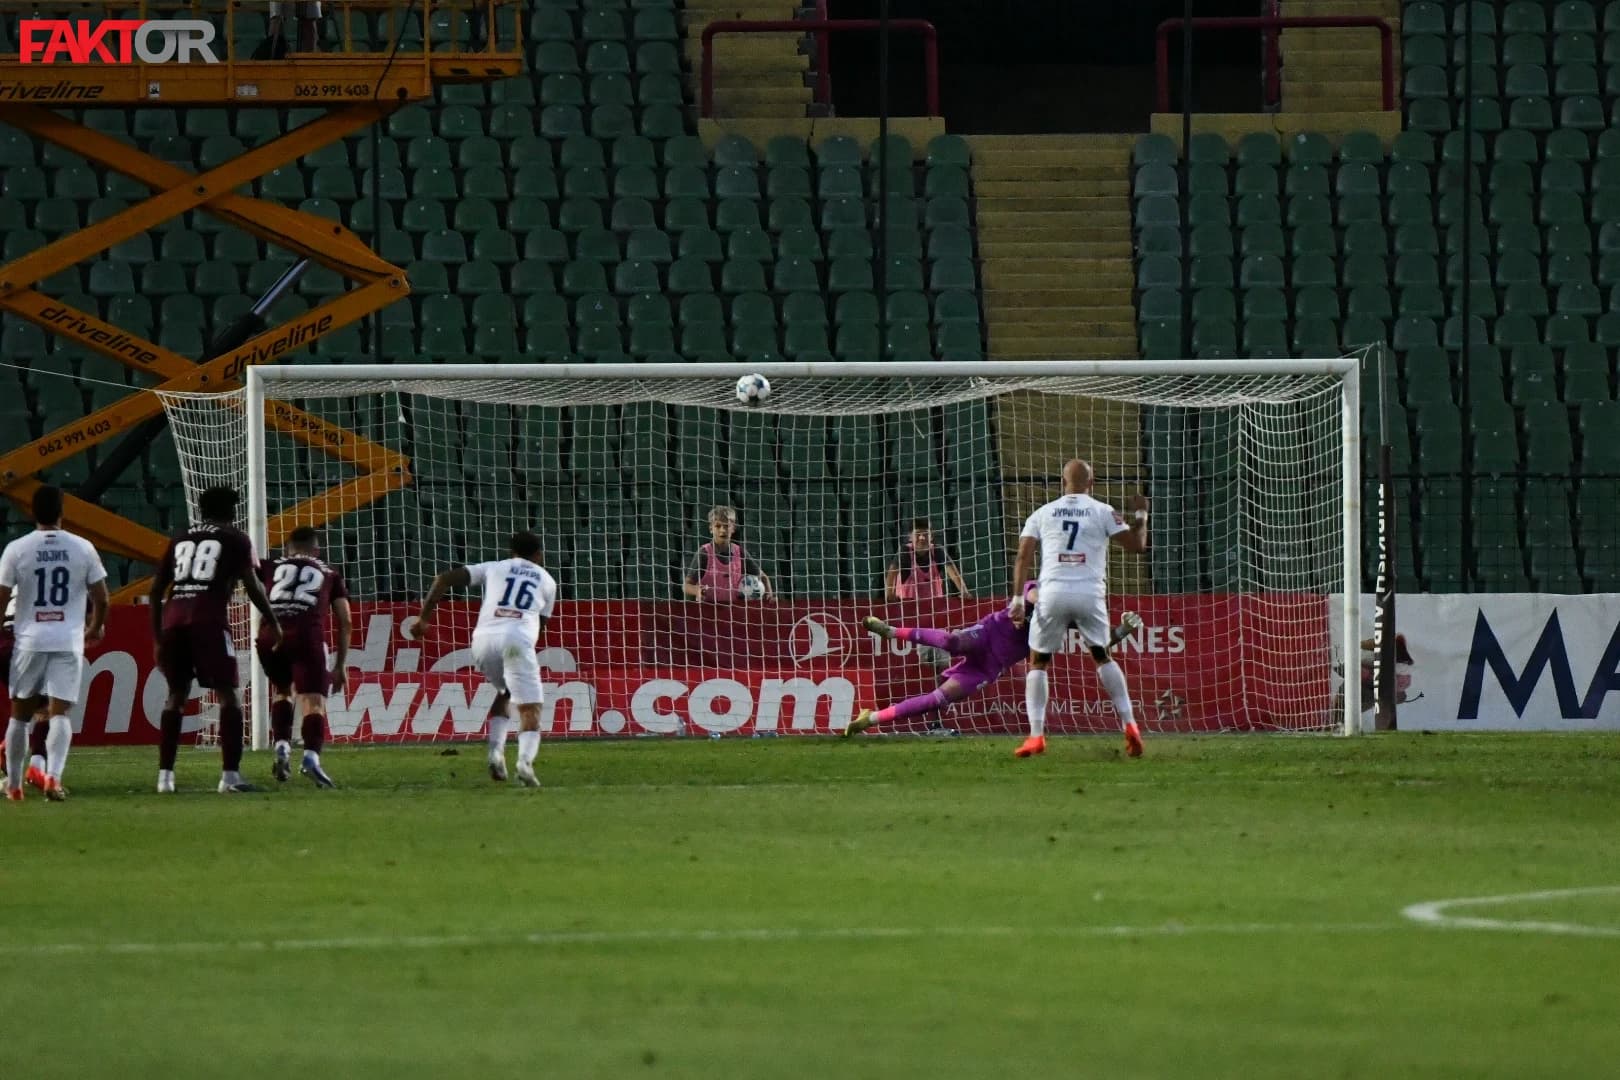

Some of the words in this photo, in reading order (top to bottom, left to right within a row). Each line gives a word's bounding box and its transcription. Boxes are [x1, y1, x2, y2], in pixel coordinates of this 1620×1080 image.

[0, 82, 104, 100] riveline
[294, 84, 319, 97] 062
[321, 84, 343, 97] 991
[345, 84, 369, 97] 403
[40, 306, 159, 365] driveline
[224, 313, 332, 380] driveline
[39, 439, 63, 457] 062
[64, 430, 87, 446] 991
[87, 420, 111, 437] 403
[1063, 520, 1079, 550] 7
[34, 566, 70, 607] 18
[269, 564, 325, 607] 22
[498, 577, 537, 610] 16
[1051, 700, 1143, 714] MEMBR
